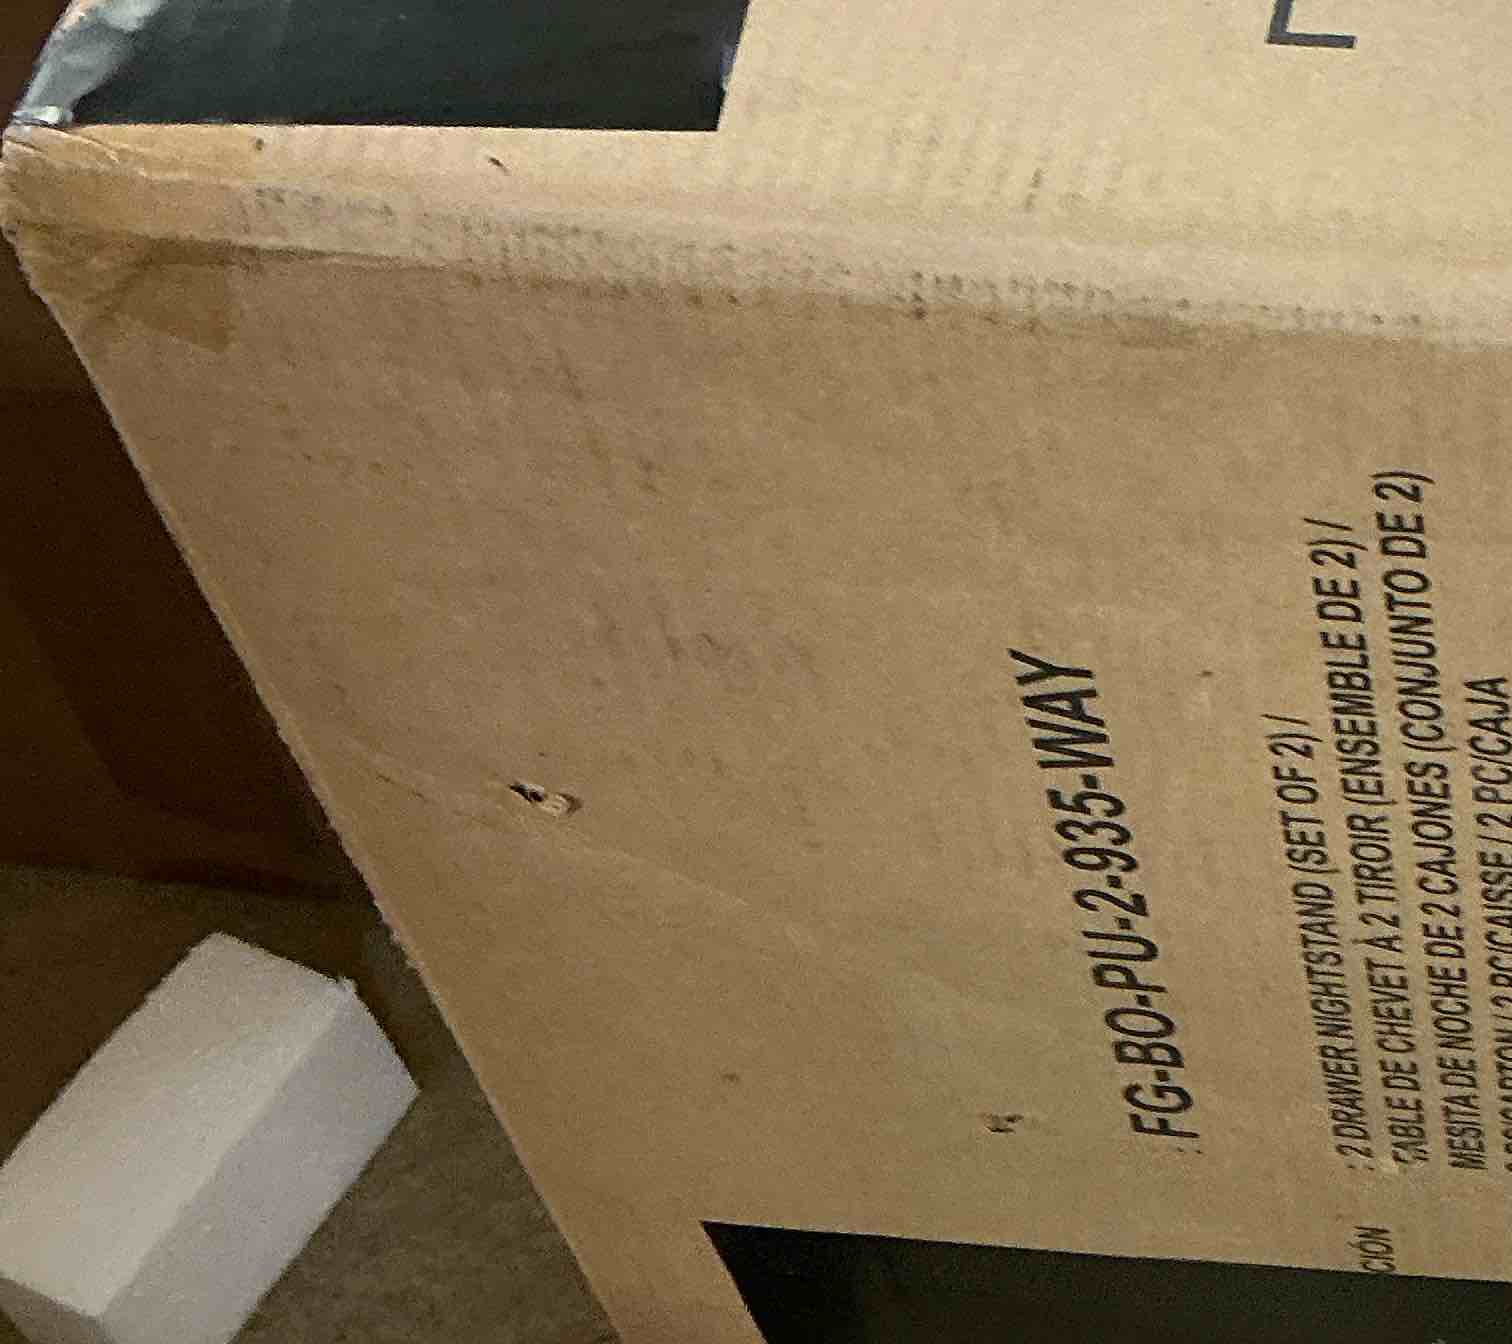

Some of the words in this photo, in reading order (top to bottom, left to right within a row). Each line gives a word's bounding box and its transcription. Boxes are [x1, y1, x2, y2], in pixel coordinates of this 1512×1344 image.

[1367, 470, 1437, 504] 2)
[1304, 539, 1369, 570] 2)
[1374, 511, 1428, 560] DE
[1310, 576, 1366, 624] DE
[1382, 568, 1458, 753] (CONJUNTO
[1318, 631, 1398, 807] (ENSEMBLE
[1264, 731, 1323, 760] 2)
[1271, 766, 1319, 806] OF
[1278, 810, 1340, 874] (SET
[1402, 760, 1460, 896] CAJONES
[1345, 813, 1398, 906] TIROIR
[1006, 648, 1200, 1140] FG-BO-PU-2-935-WAY
[1420, 902, 1462, 920] 2
[1350, 936, 1404, 954] À
[1356, 912, 1401, 930] 2
[1422, 922, 1468, 960] DE
[1291, 881, 1355, 1041] NIGHTSTAND
[1364, 957, 1416, 1054] CHEVET
[1422, 964, 1476, 1053] NOCHE
[1316, 1044, 1372, 1141] DRAWER
[1376, 1059, 1422, 1092] DE
[1435, 1055, 1478, 1090] DE
[1334, 1145, 1374, 1159] 2
[1383, 1096, 1430, 1164] TABLE
[1440, 1094, 1489, 1171] MESITA
